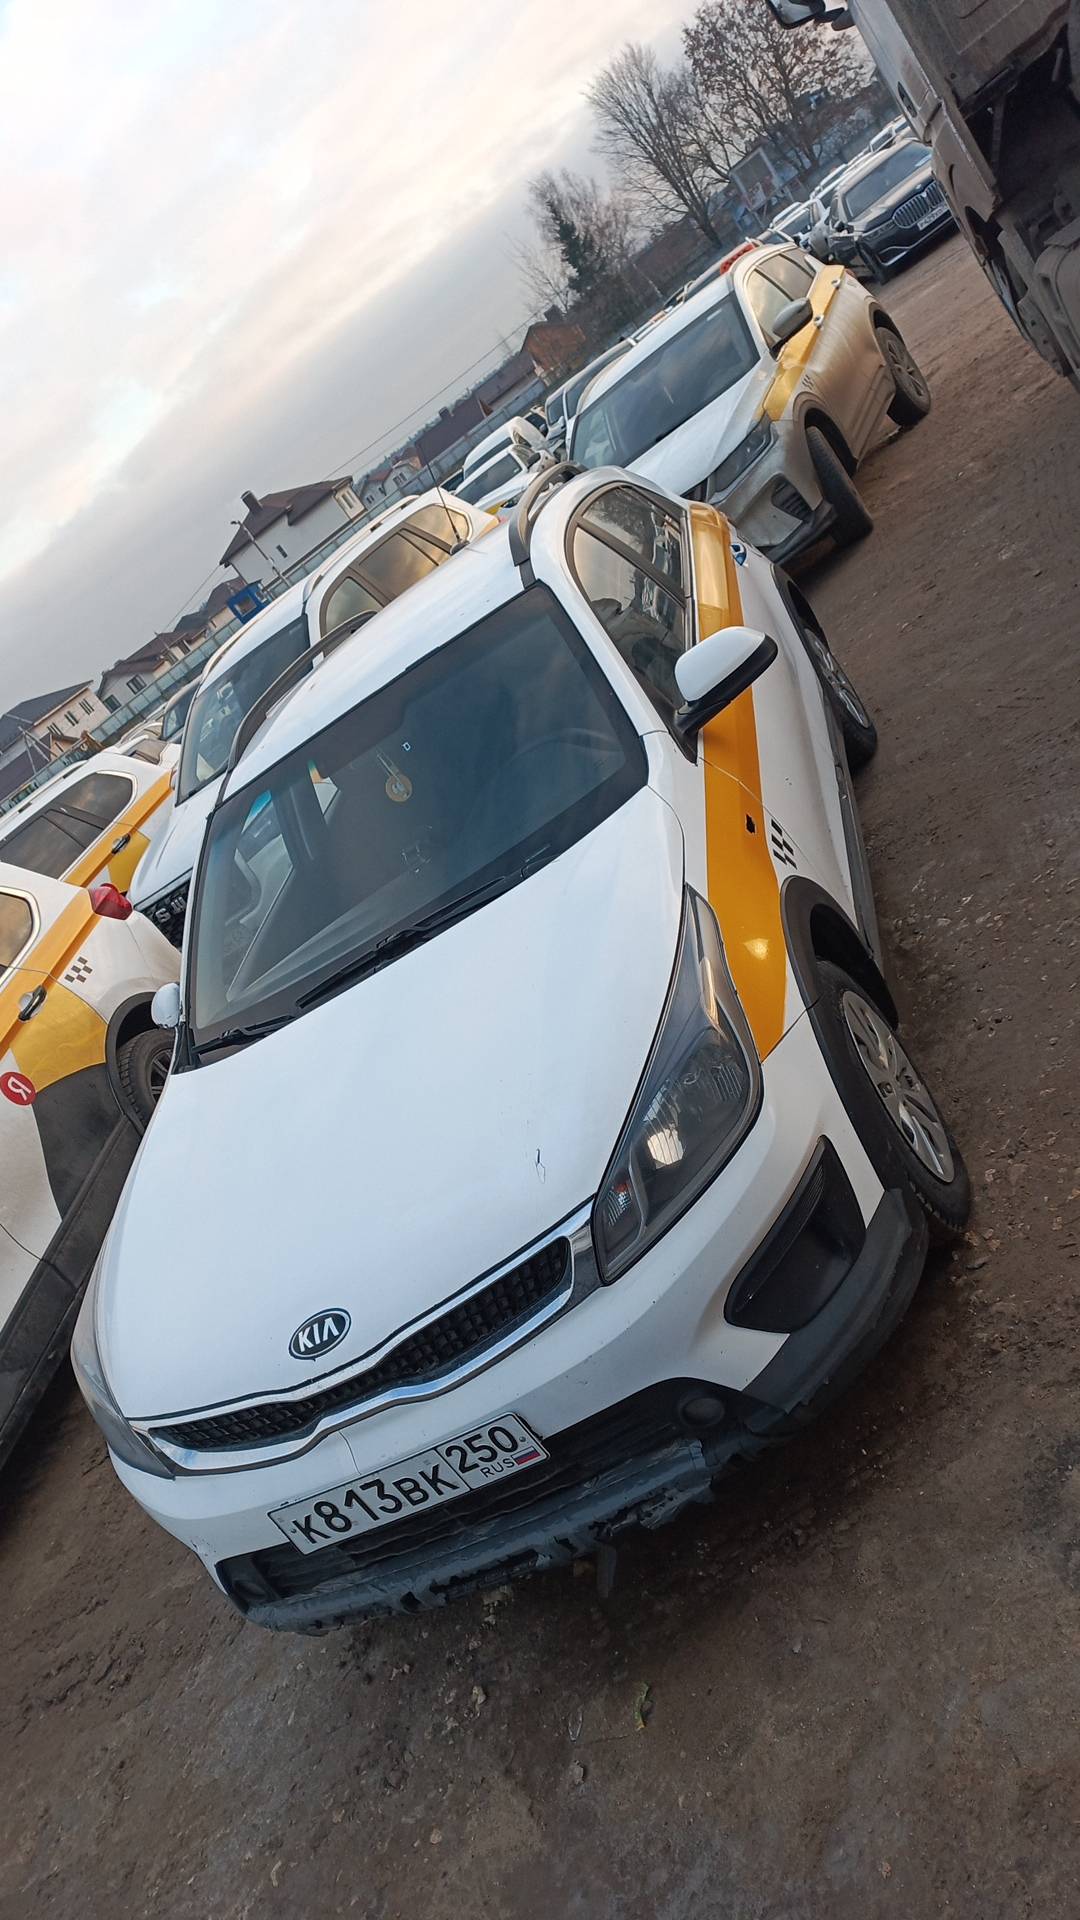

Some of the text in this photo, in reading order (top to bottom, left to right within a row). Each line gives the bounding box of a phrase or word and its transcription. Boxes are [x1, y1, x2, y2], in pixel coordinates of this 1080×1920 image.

[298, 1317, 339, 1352] KIA
[445, 1426, 519, 1474] 250
[479, 1457, 515, 1478] RUS
